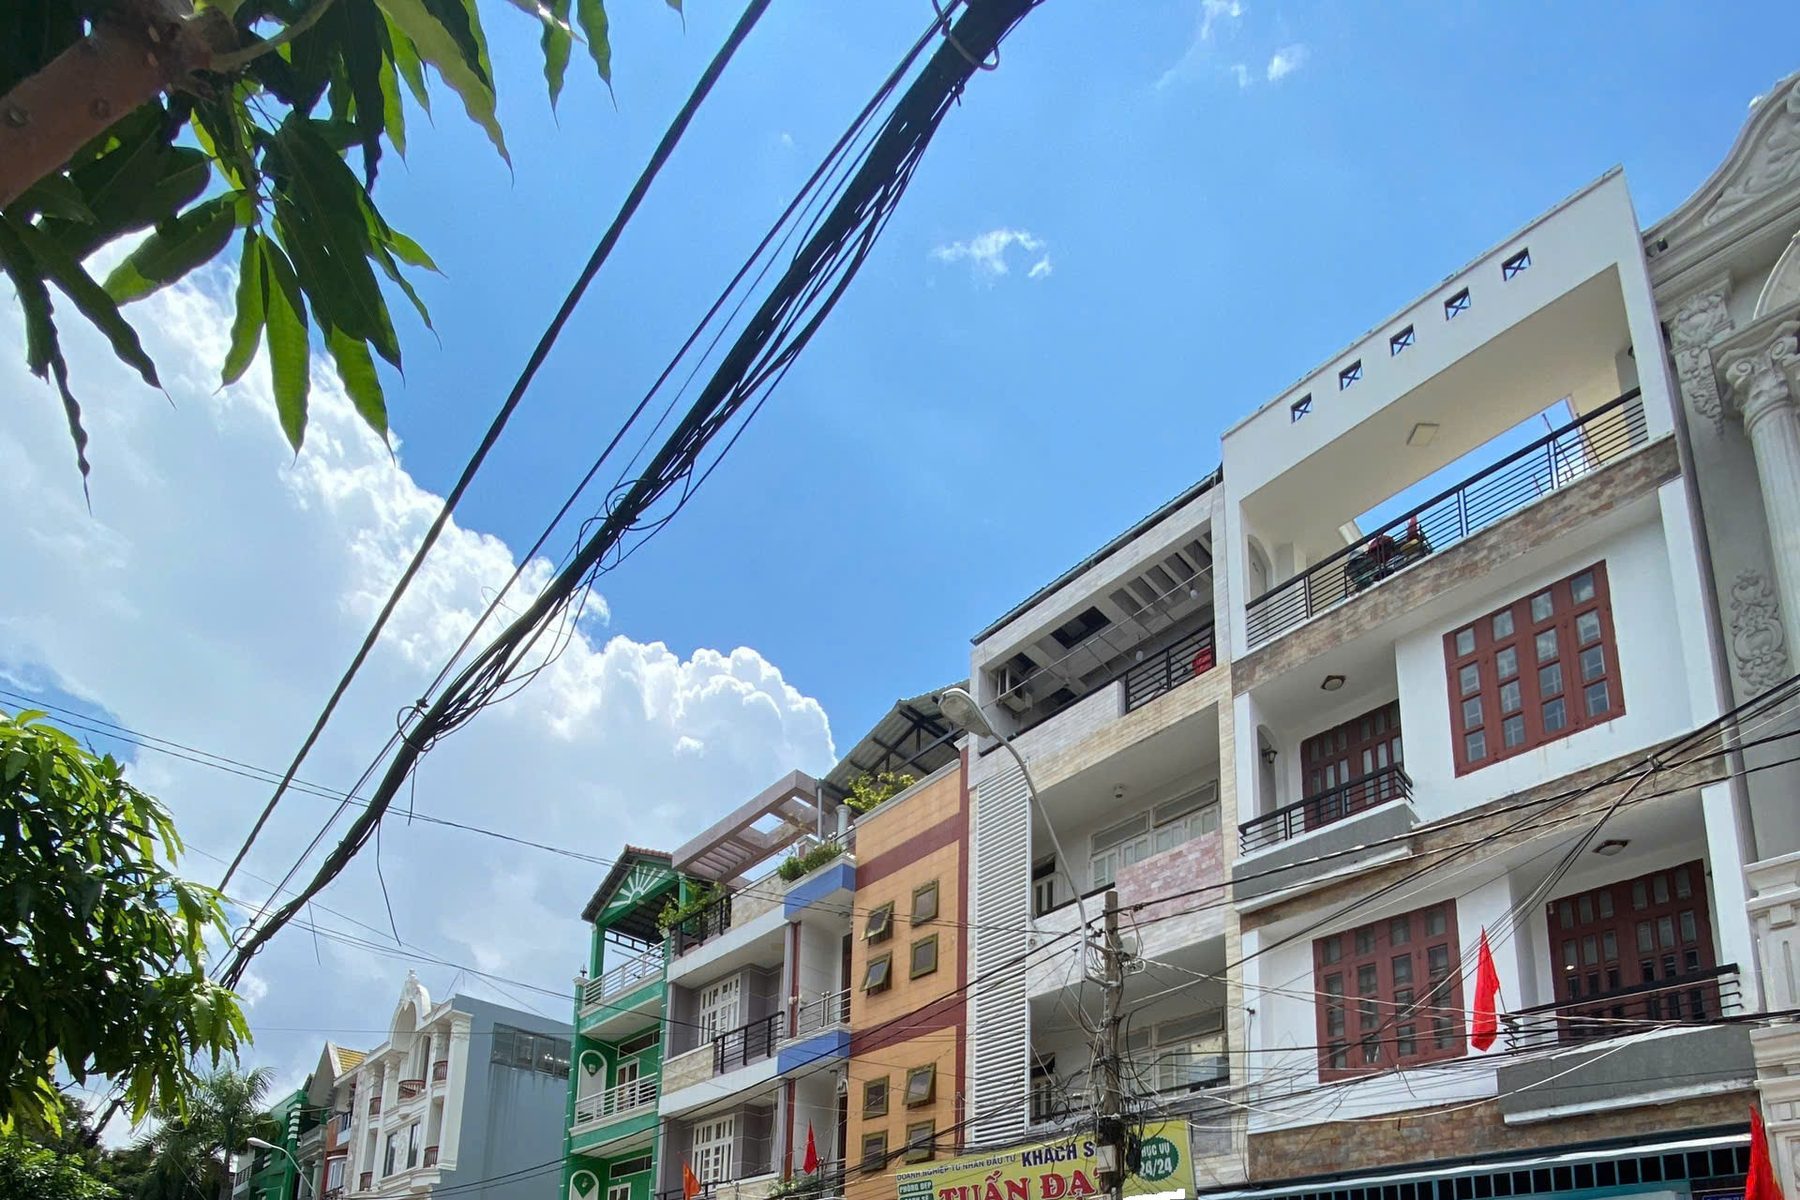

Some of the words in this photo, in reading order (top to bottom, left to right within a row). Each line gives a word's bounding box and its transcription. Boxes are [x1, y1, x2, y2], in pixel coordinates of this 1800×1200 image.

[1140, 1144, 1157, 1158] HỤC
[1160, 1142, 1170, 1156] VỤ
[1140, 1157, 1173, 1177] 24/24
[897, 1171, 920, 1181] DOANH
